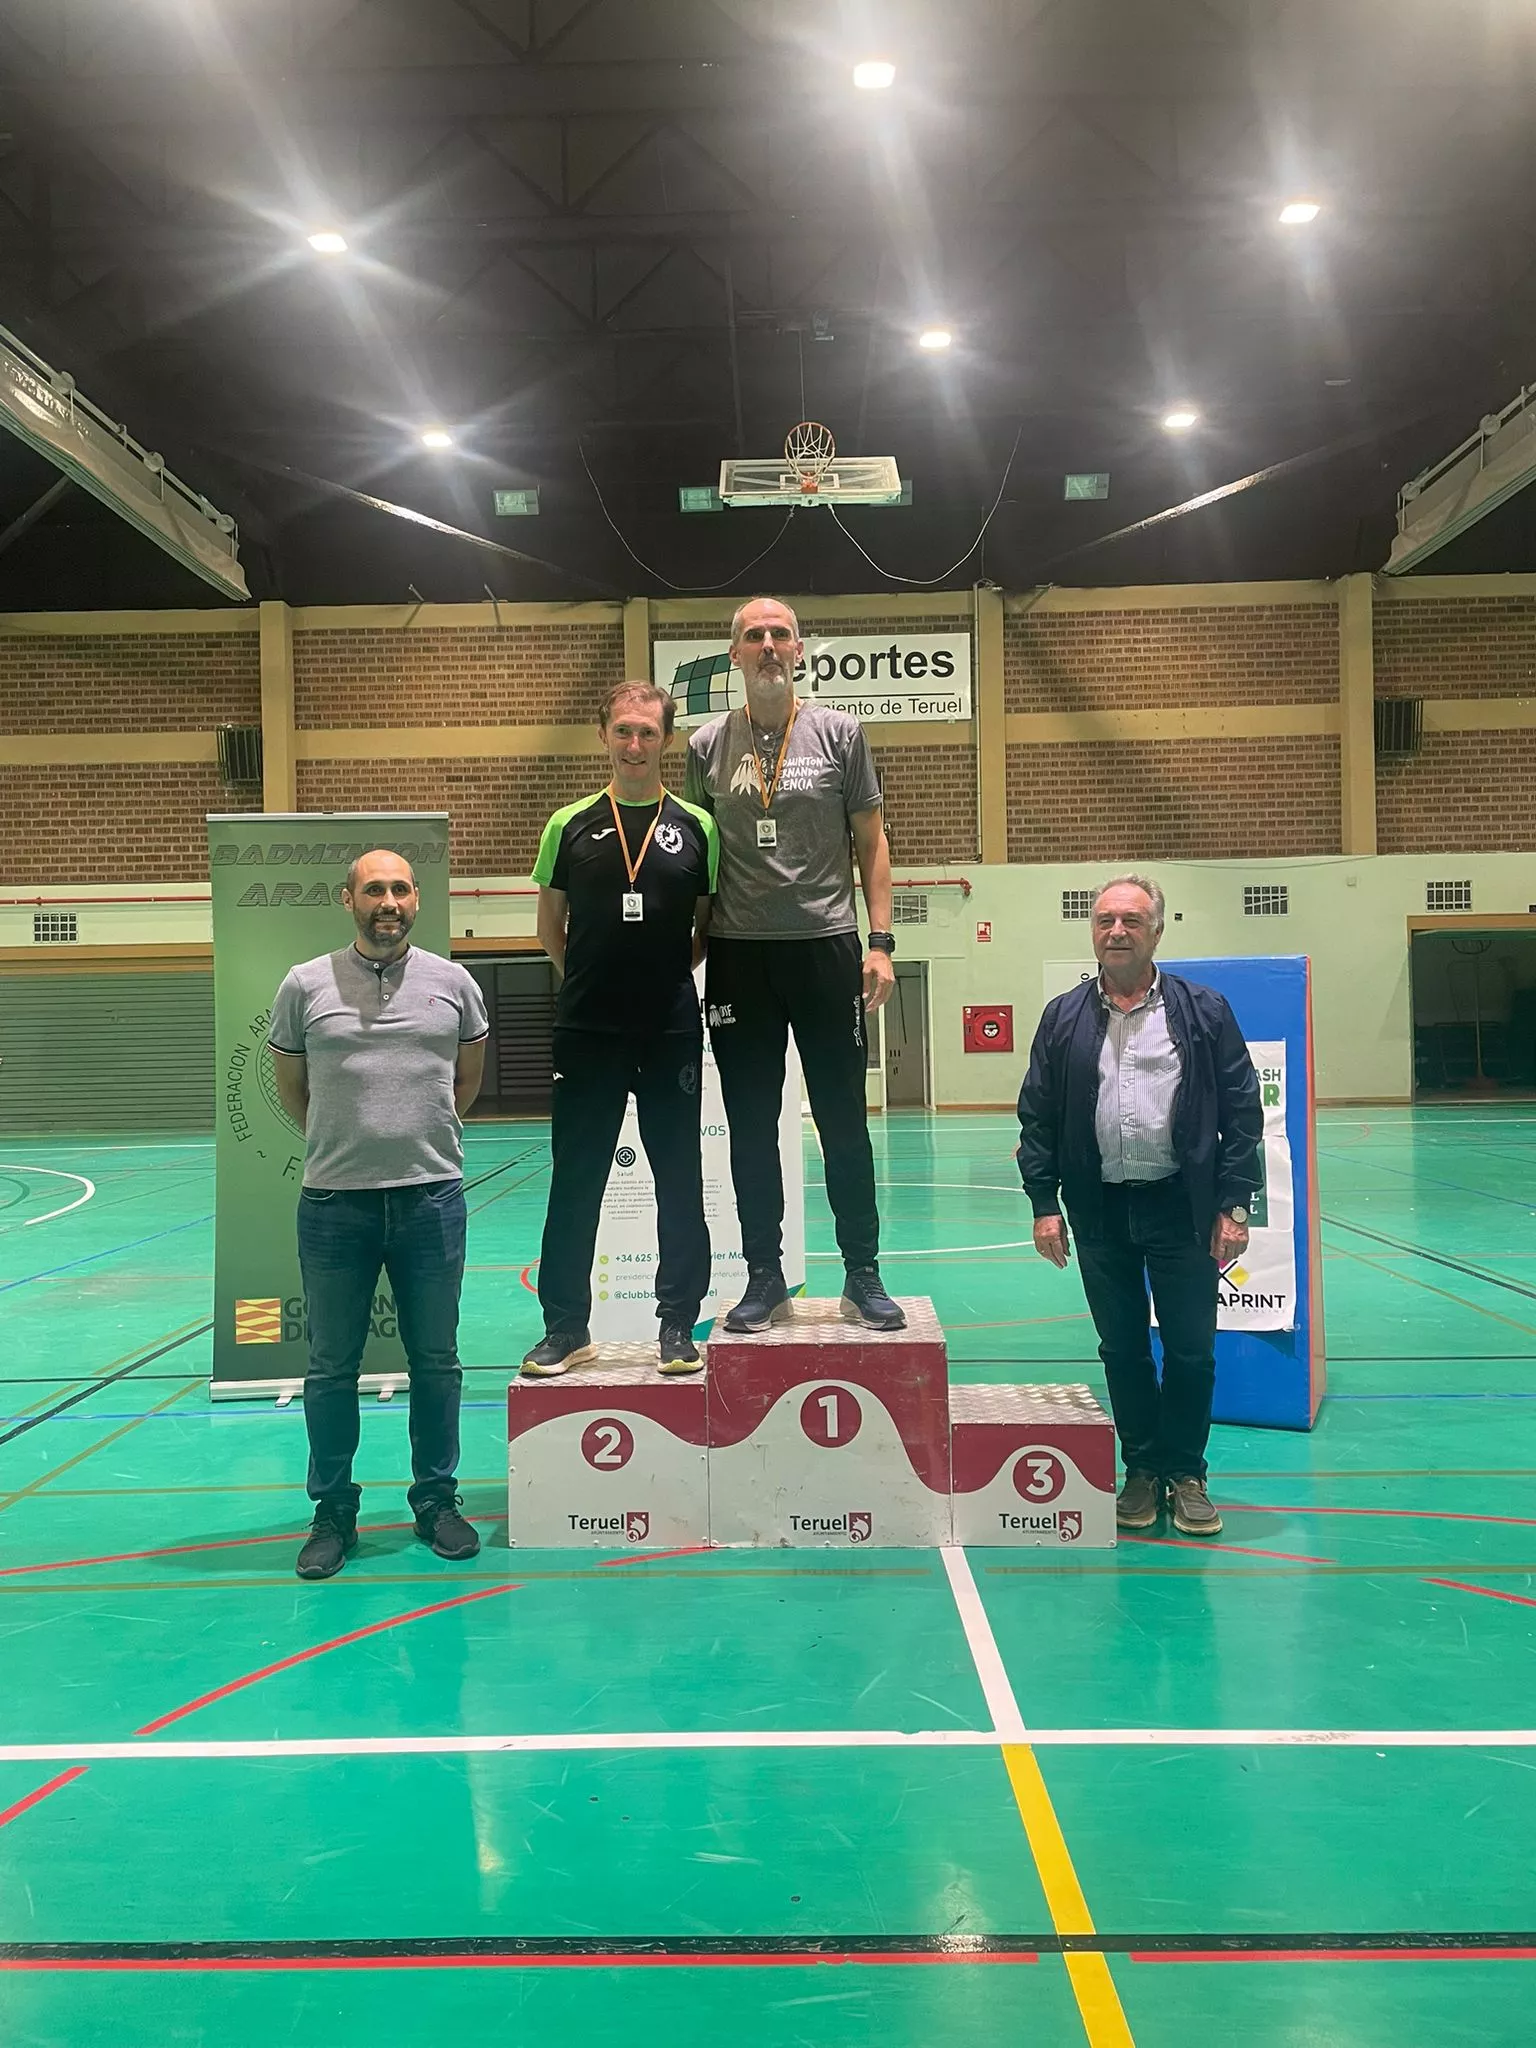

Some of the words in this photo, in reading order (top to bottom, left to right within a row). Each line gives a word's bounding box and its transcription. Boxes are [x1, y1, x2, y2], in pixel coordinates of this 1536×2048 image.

[793, 644, 955, 691] eportes
[880, 699, 902, 714] de
[908, 698, 962, 714] Teruel
[763, 777, 814, 792] VLENCIA
[1255, 1068, 1281, 1082] SH
[700, 1125, 726, 1136] VOS
[615, 1254, 632, 1263] +34
[635, 1253, 652, 1263] 625
[1217, 1293, 1286, 1309] APRINT
[818, 1394, 839, 1438] 1
[594, 1425, 622, 1464] 2
[1026, 1459, 1054, 1496] 3
[568, 1513, 625, 1530] Teruel
[789, 1514, 847, 1531] Teruel
[998, 1512, 1057, 1529] Teruel
